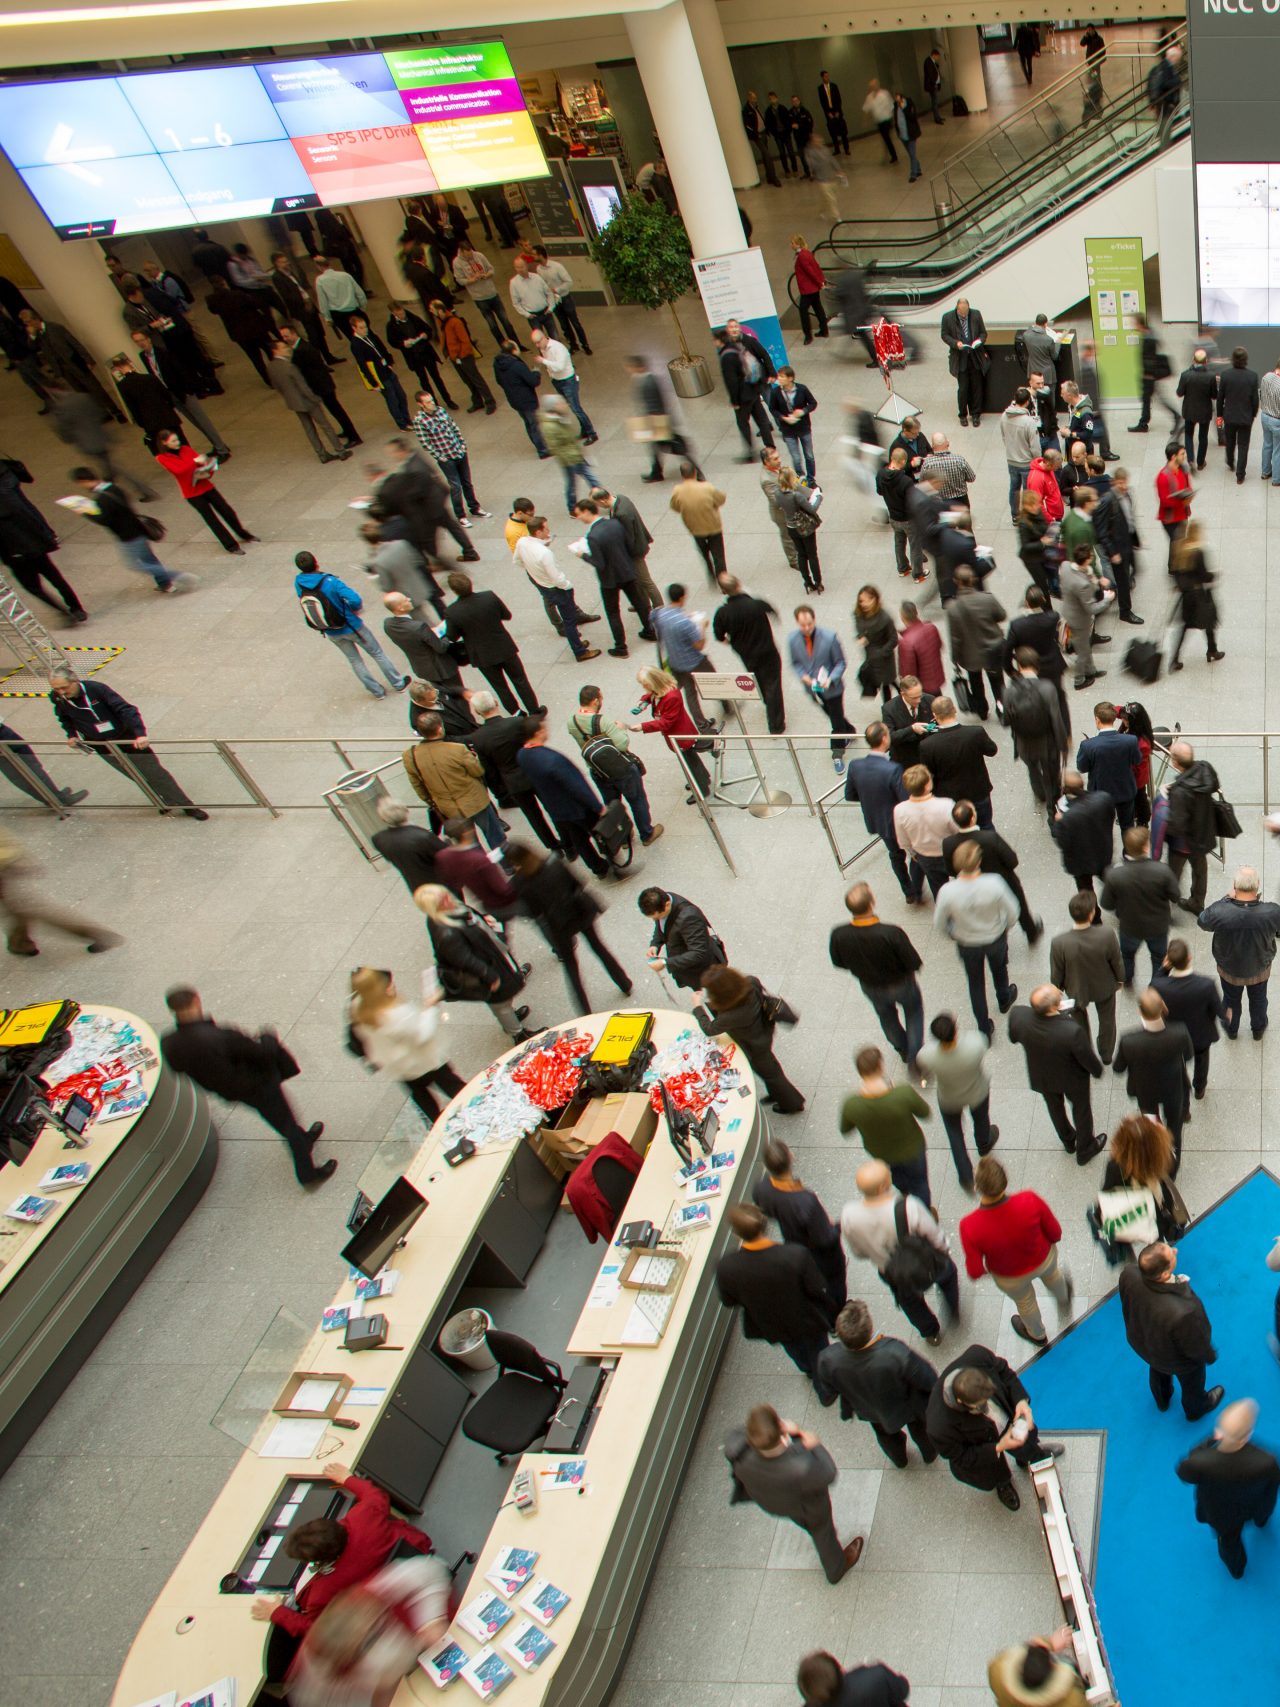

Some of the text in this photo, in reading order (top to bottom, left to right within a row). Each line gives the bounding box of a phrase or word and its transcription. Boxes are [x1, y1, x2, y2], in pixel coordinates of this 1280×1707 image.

[410, 88, 502, 105] Industrielle Kommunikation
[414, 100, 490, 114] Industrial communication
[164, 127, 184, 151] 1
[214, 121, 233, 147] 6
[327, 131, 357, 145] SPS
[361, 127, 382, 142] IPC
